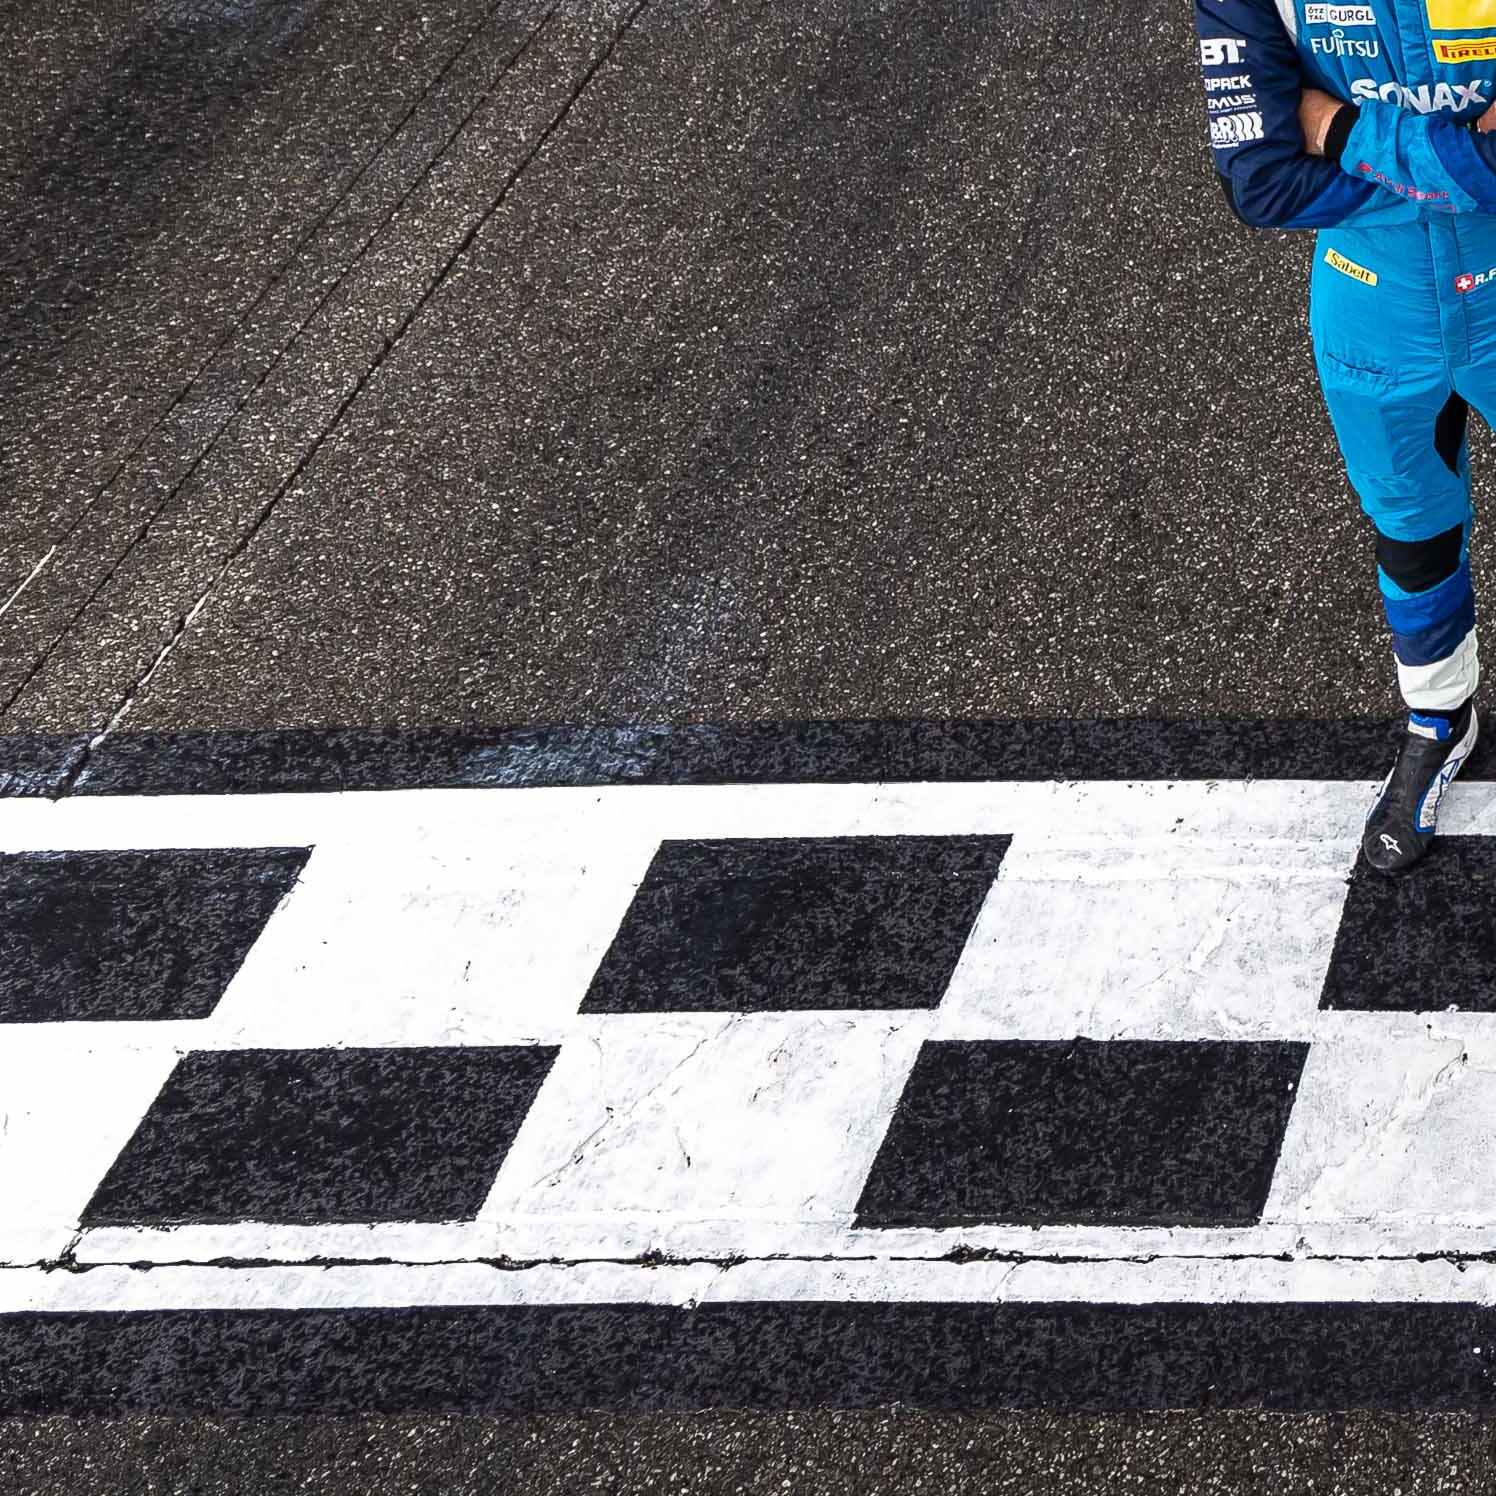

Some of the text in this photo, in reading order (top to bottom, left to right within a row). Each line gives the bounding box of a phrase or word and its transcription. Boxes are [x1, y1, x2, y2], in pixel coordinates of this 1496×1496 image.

[1329, 8, 1374, 22] GURGL
[1199, 38, 1247, 66] BT
[1310, 29, 1379, 58] FUJITSU
[1349, 78, 1488, 115] SONAX
[1329, 252, 1371, 283] Sabelt
